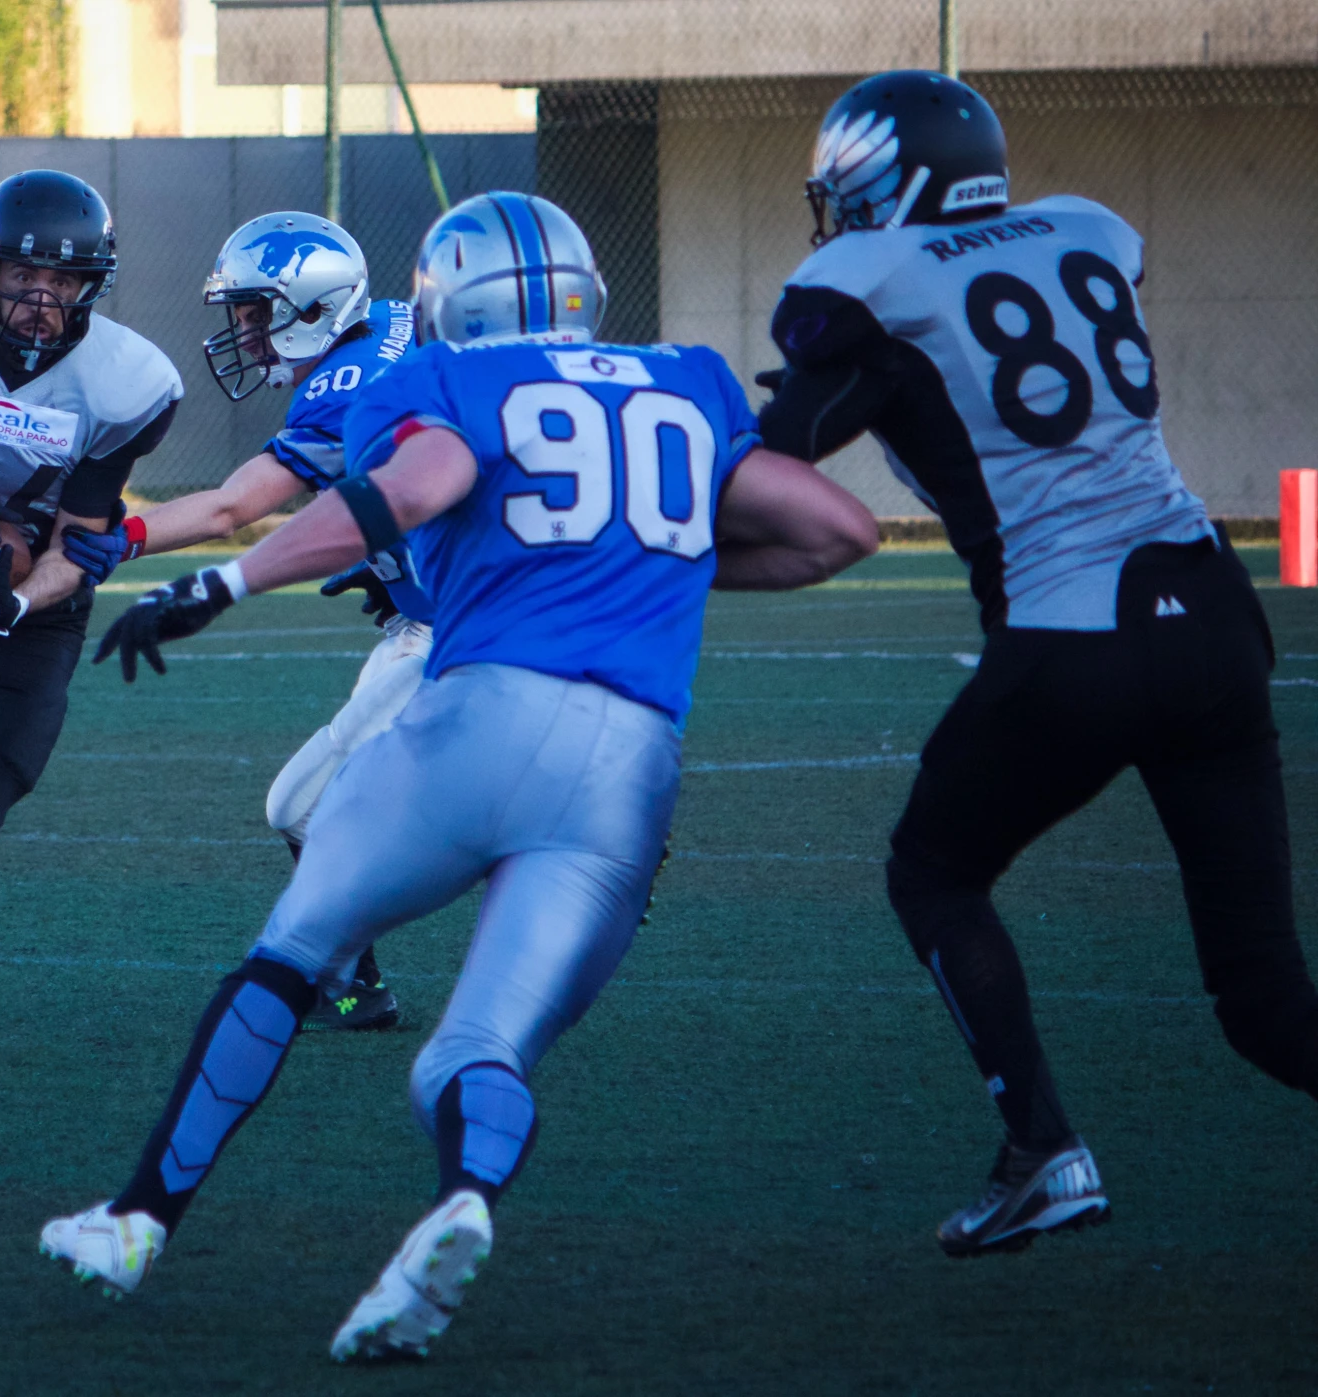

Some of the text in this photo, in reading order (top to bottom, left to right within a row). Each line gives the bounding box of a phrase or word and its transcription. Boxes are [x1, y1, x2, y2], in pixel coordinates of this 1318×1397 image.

[955, 183, 1005, 201] schutt
[922, 217, 1055, 262] RAVENS
[377, 300, 413, 362] MADBULLS
[965, 249, 1160, 449] 88
[304, 364, 363, 400] 50
[26, 432, 69, 448] PARAJÓ
[499, 380, 717, 563] 90
